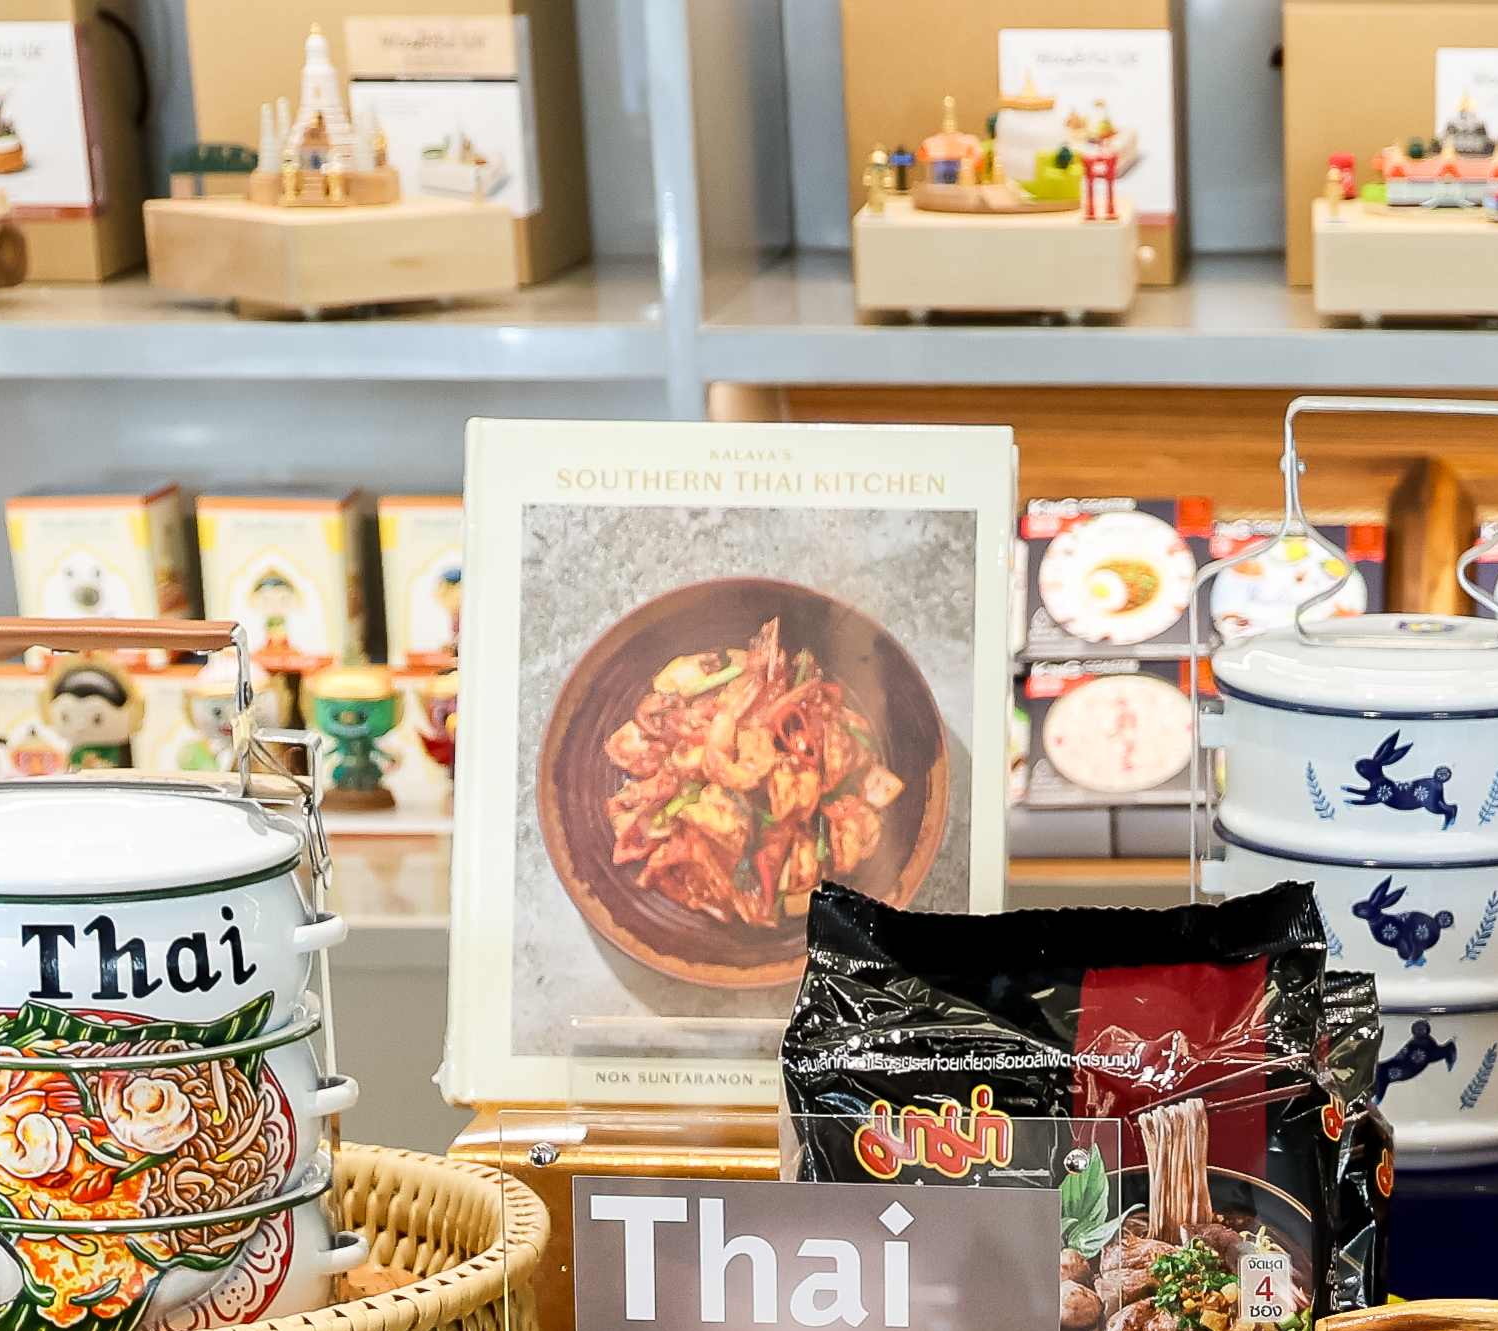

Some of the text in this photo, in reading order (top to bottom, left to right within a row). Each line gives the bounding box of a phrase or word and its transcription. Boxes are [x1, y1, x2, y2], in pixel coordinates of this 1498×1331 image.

[557, 468, 947, 495] SOUTHERN THAI KITCHEN
[21, 905, 258, 1001] Thai
[595, 1071, 630, 1083] NOK
[638, 1071, 753, 1085] SUNTARANON
[590, 1194, 915, 1328] Thai
[1255, 1276, 1274, 1302] 4
[1250, 1305, 1282, 1317] ซอง
